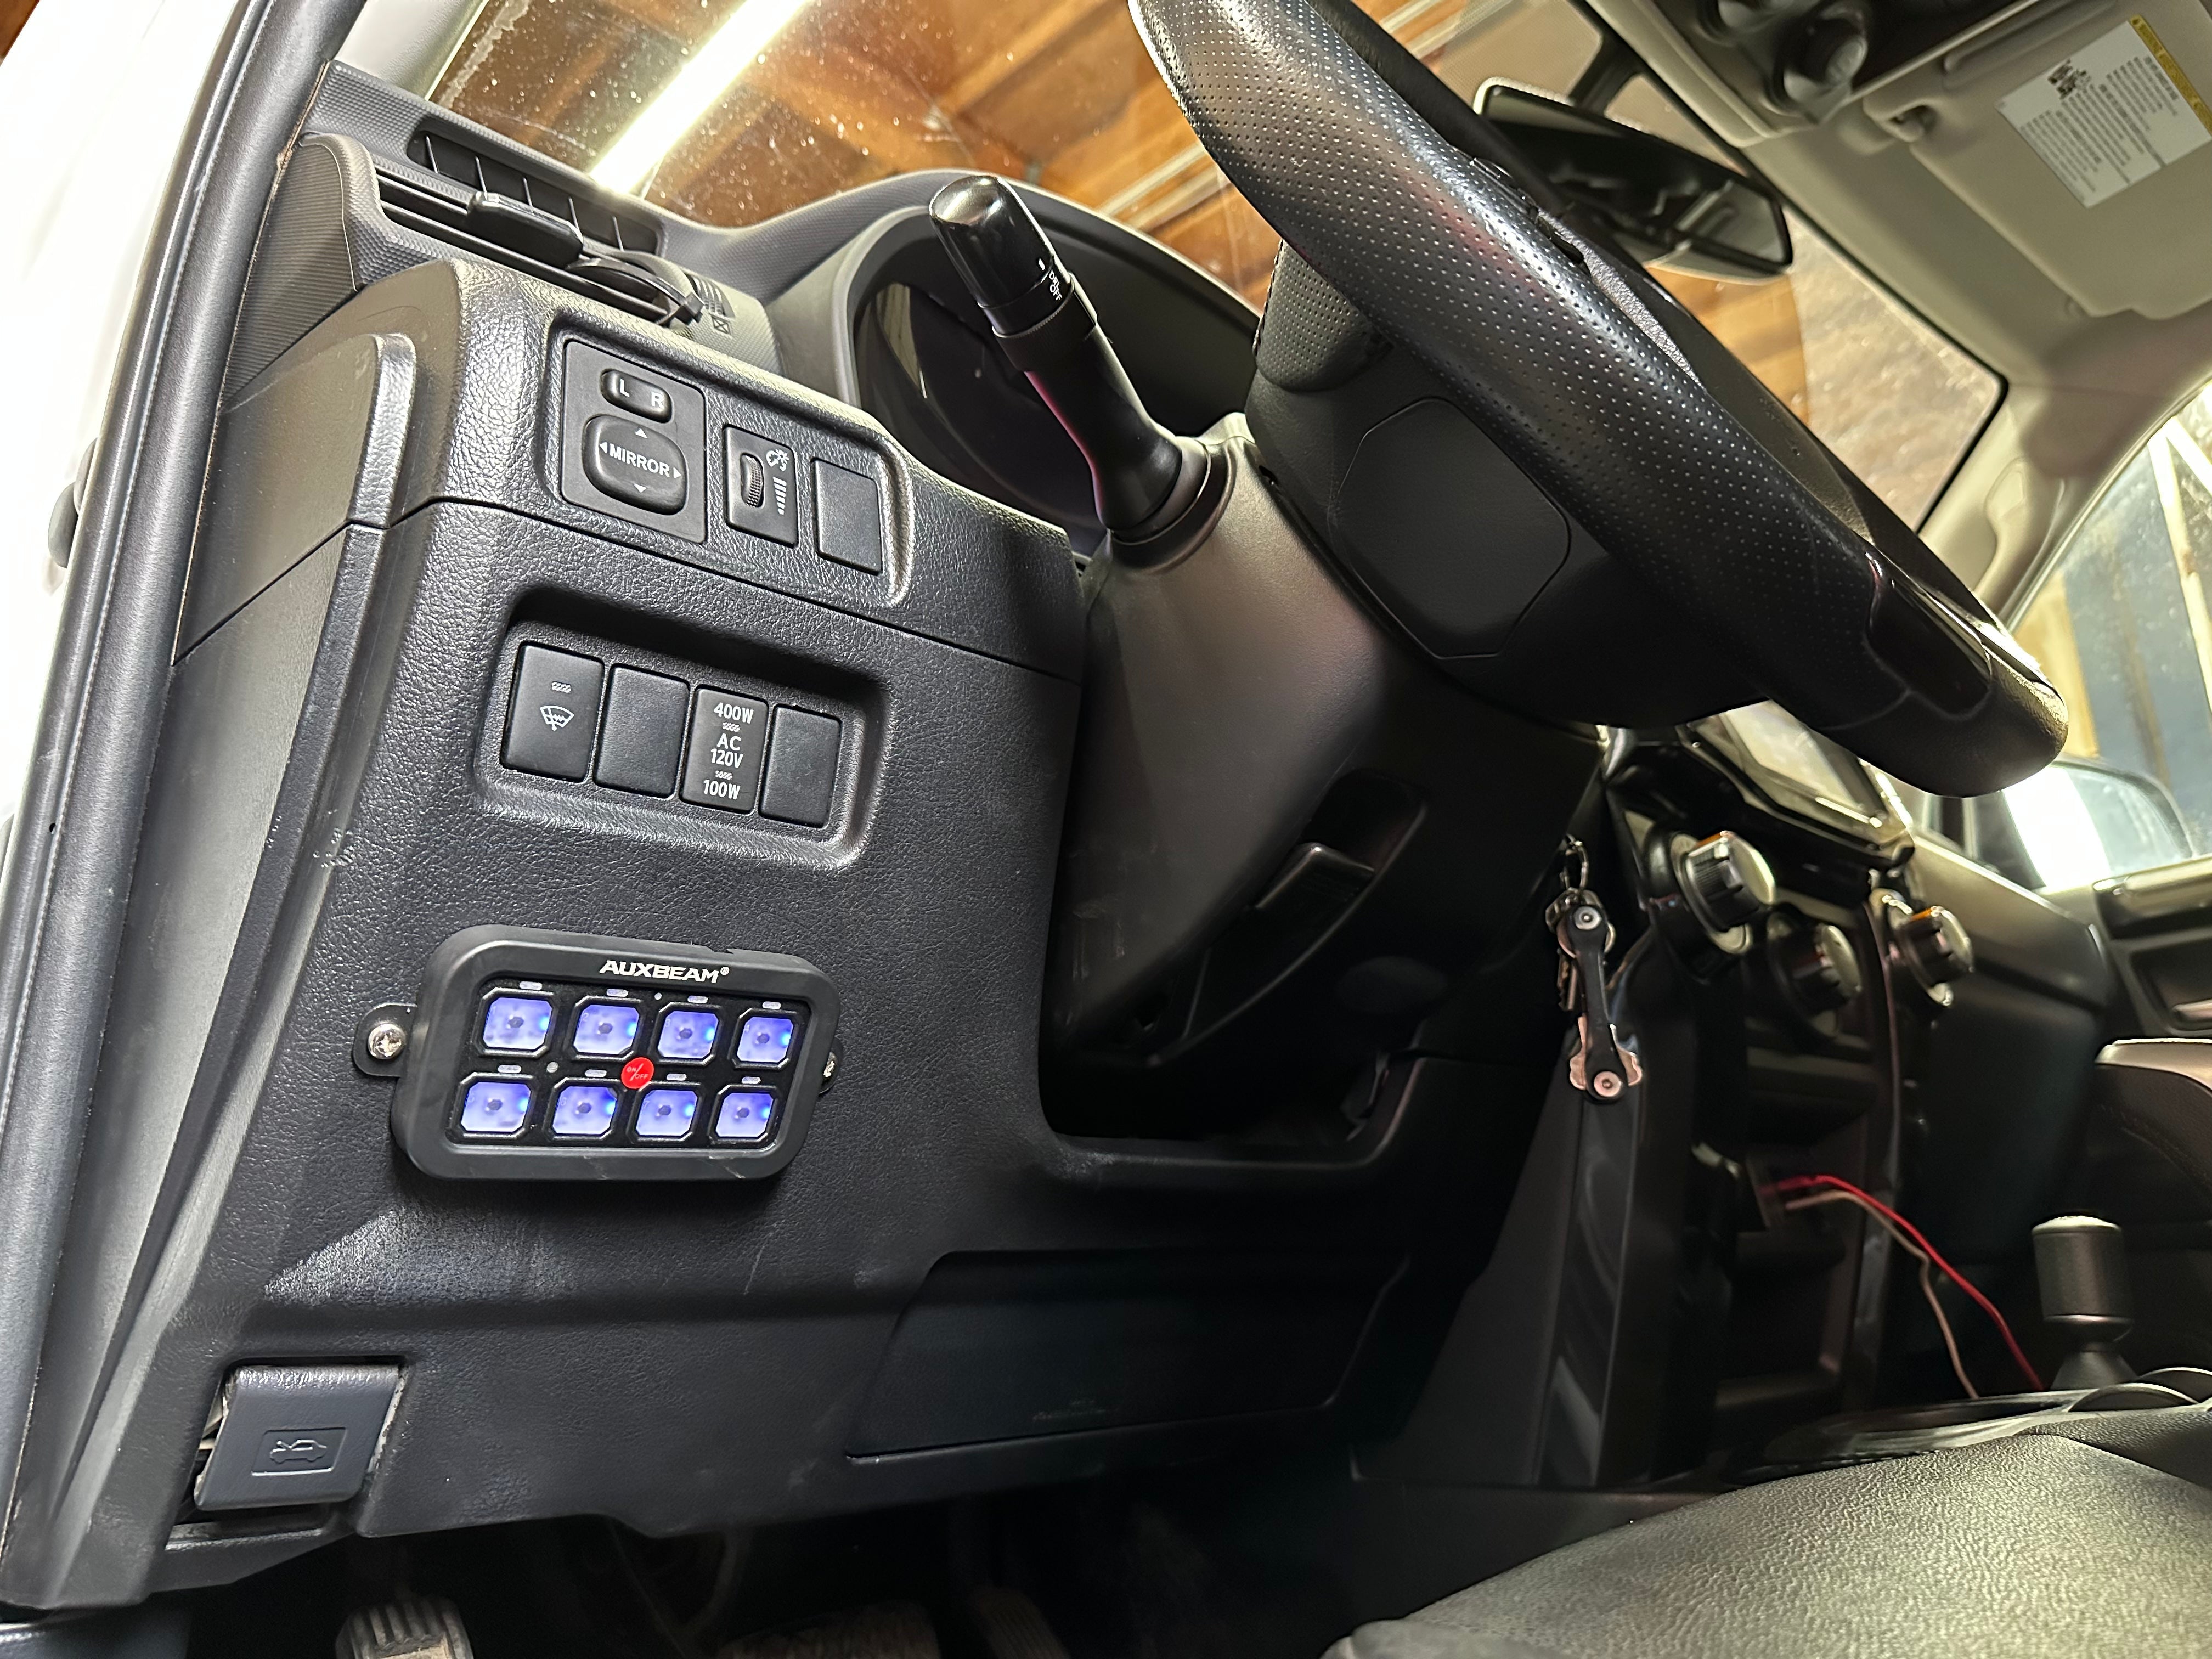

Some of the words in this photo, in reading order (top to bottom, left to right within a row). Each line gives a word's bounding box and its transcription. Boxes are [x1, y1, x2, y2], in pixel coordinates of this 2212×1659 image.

[1049, 269, 1060, 291] DRL
[1050, 284, 1063, 301] OFF
[620, 379, 630, 397] L
[651, 392, 664, 409] R
[610, 443, 670, 478] MIRROR
[714, 702, 754, 724] 400W
[716, 733, 742, 751] AC
[710, 748, 744, 769] 120V
[703, 779, 741, 800] 100W
